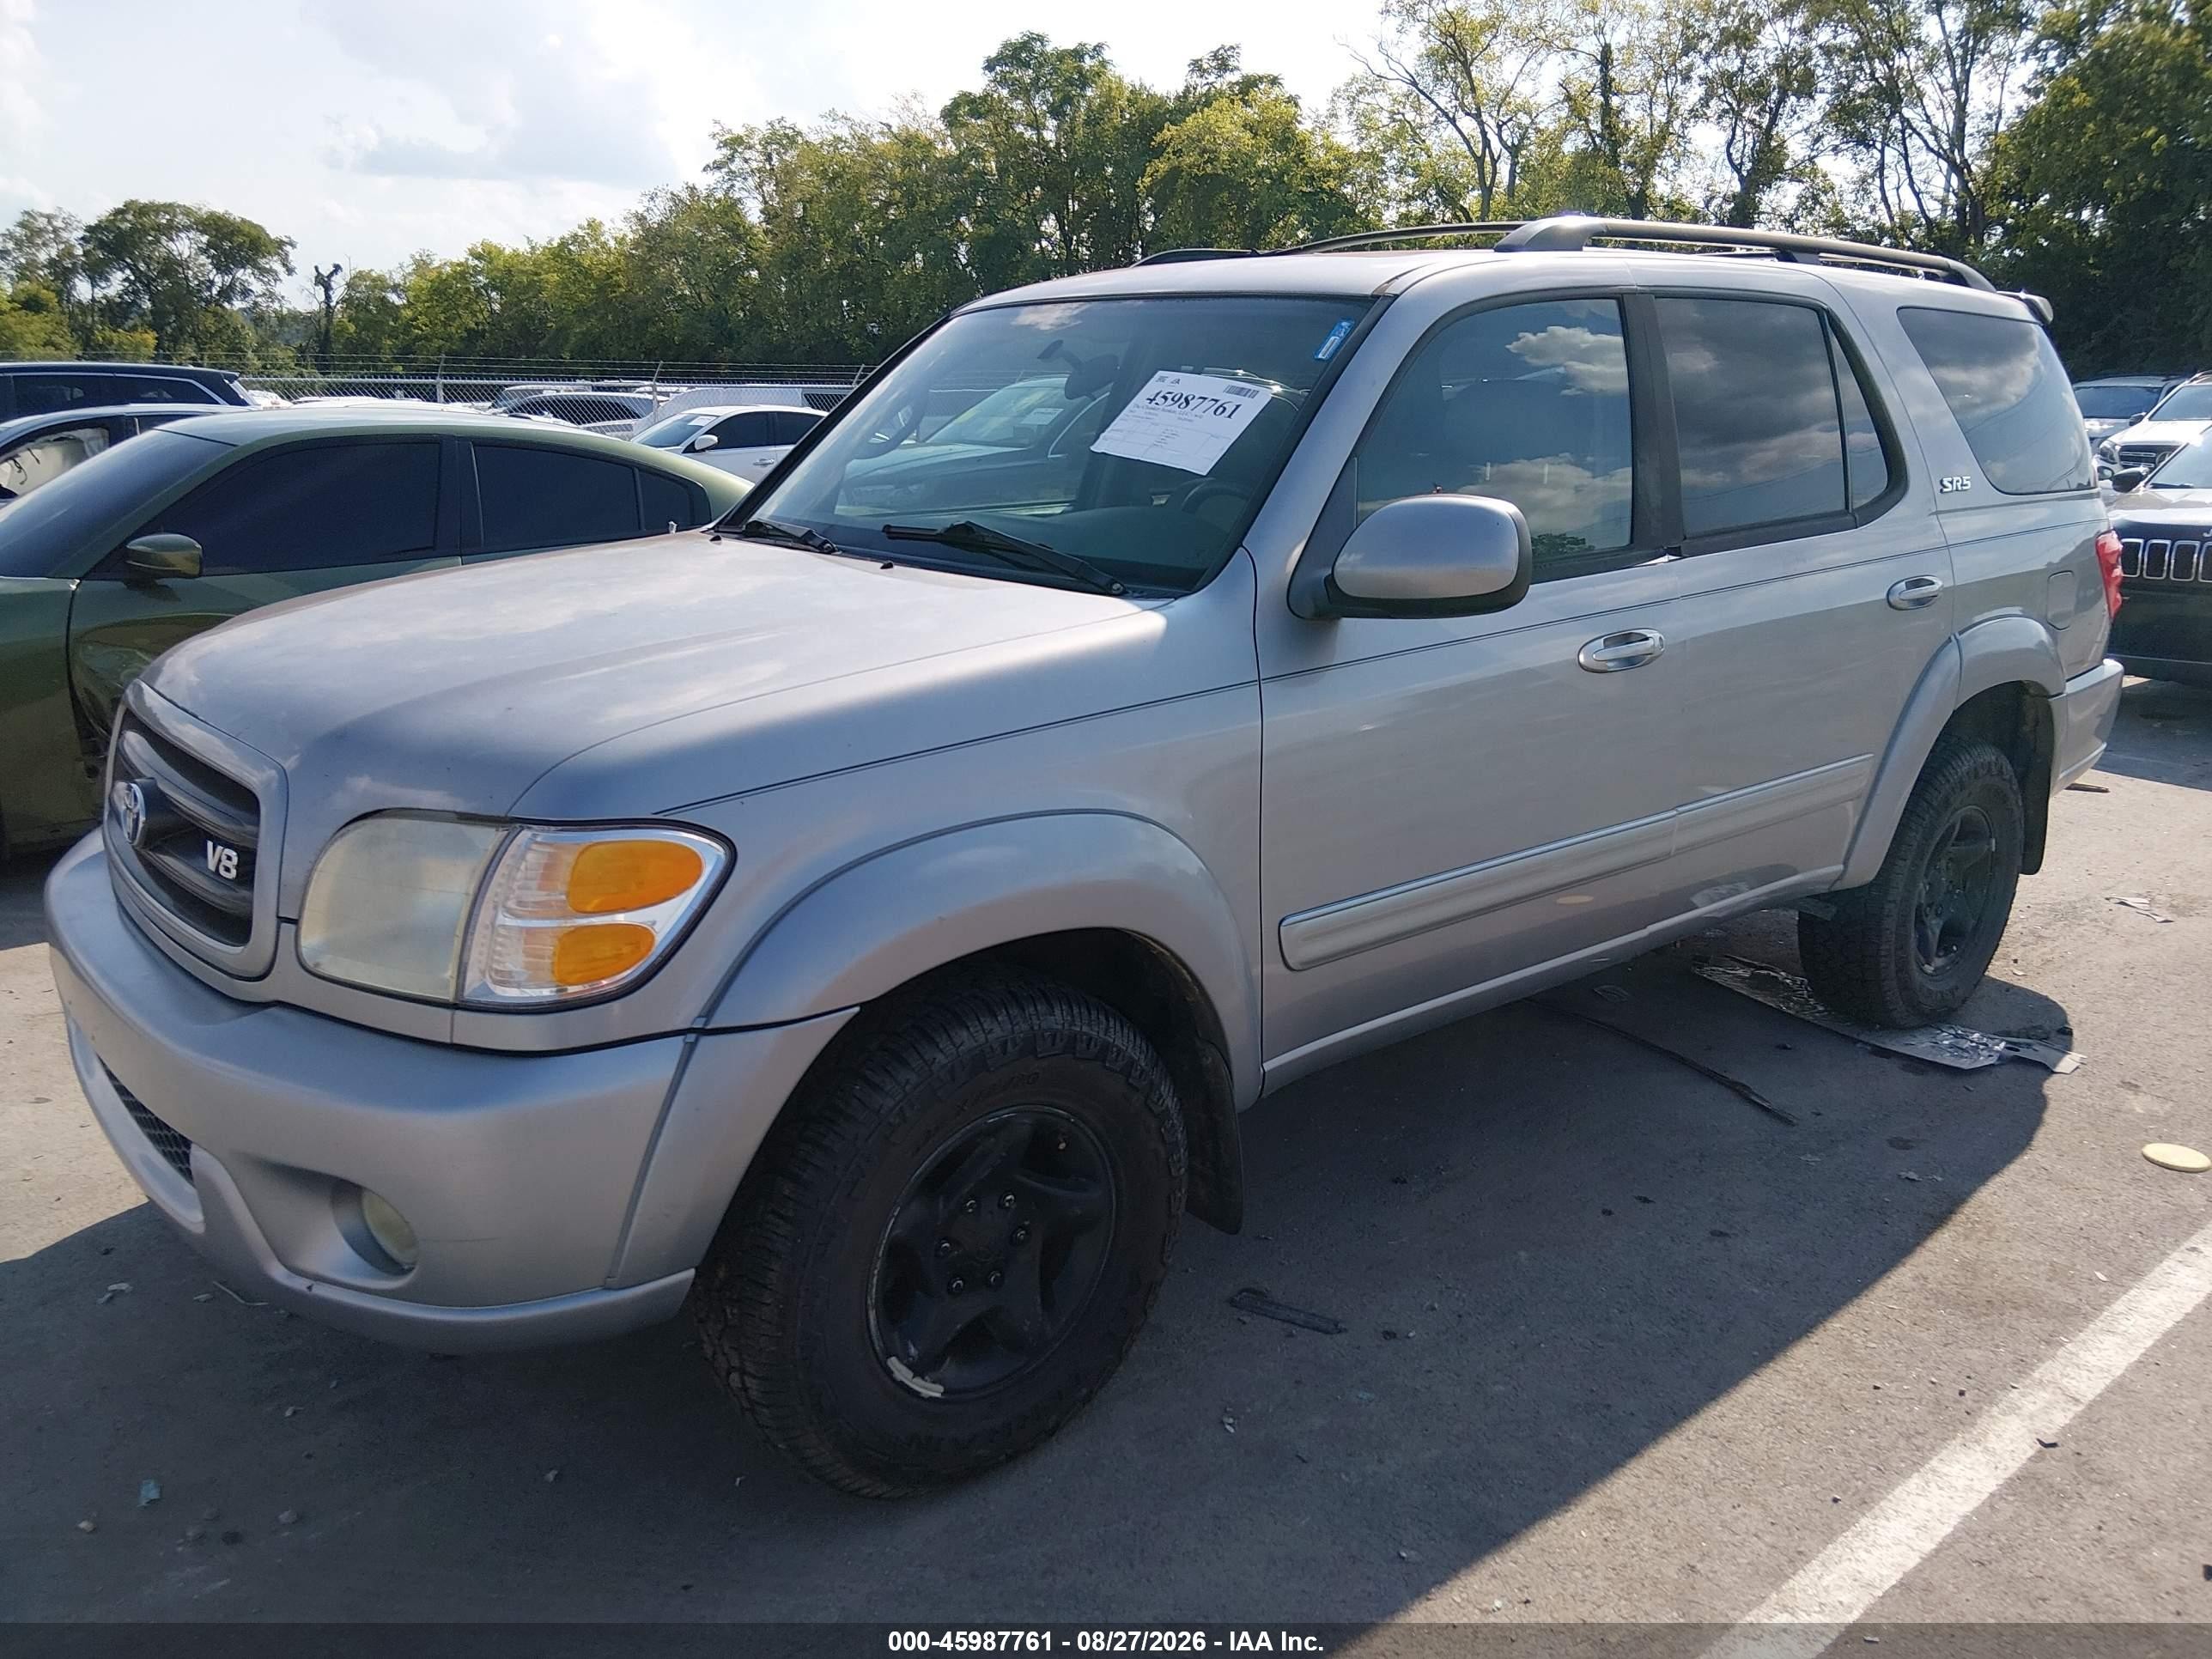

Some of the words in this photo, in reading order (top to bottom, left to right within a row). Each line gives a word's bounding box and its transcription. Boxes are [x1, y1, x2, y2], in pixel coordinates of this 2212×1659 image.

[1146, 390, 1243, 419] 45987761
[1941, 476, 1972, 493] SR5
[206, 840, 238, 879] V8
